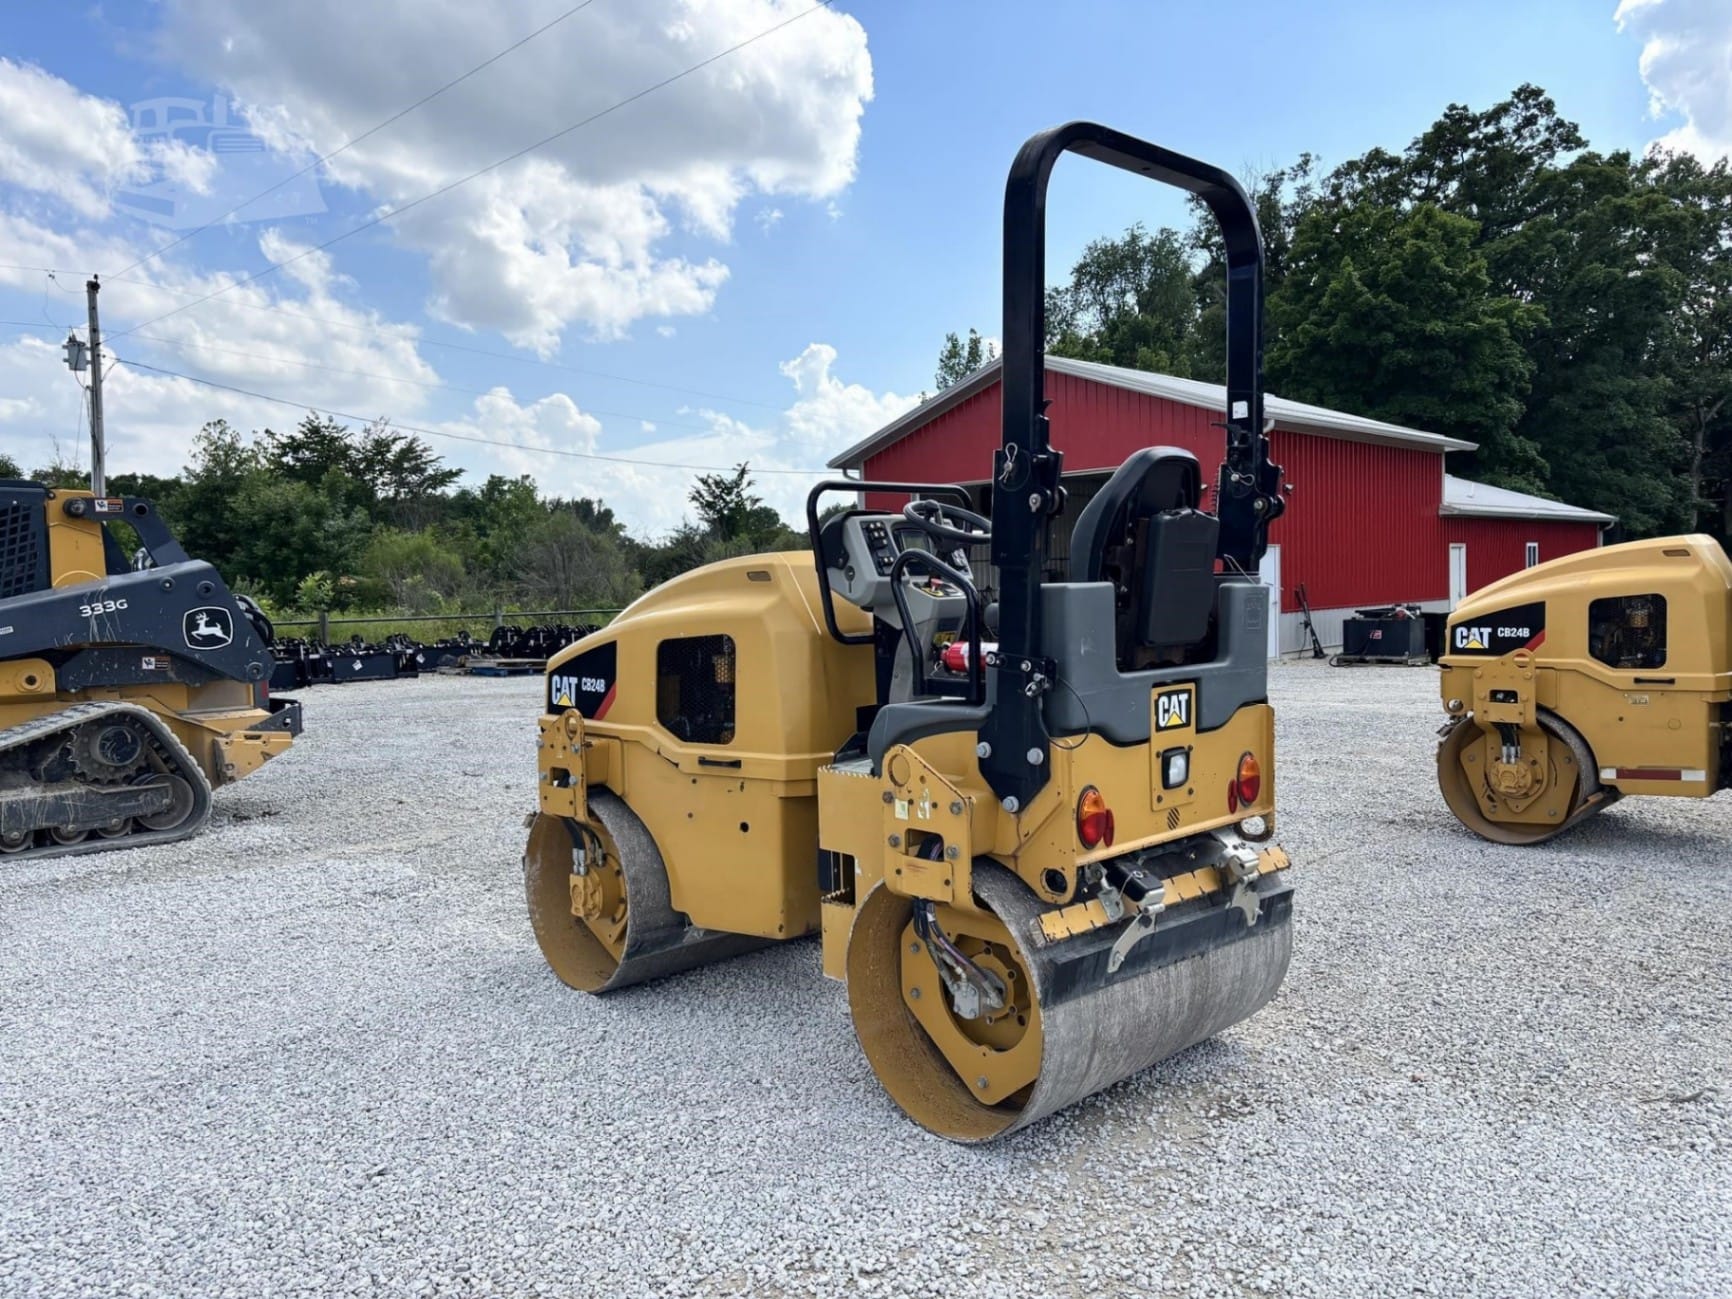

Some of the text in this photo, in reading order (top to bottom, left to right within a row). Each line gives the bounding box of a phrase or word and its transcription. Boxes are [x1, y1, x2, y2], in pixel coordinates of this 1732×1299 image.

[79, 599, 128, 617] 333G
[1456, 626, 1530, 649] CAT CB24B
[551, 675, 606, 707] CAT CB24B
[1158, 693, 1188, 727] CAT
